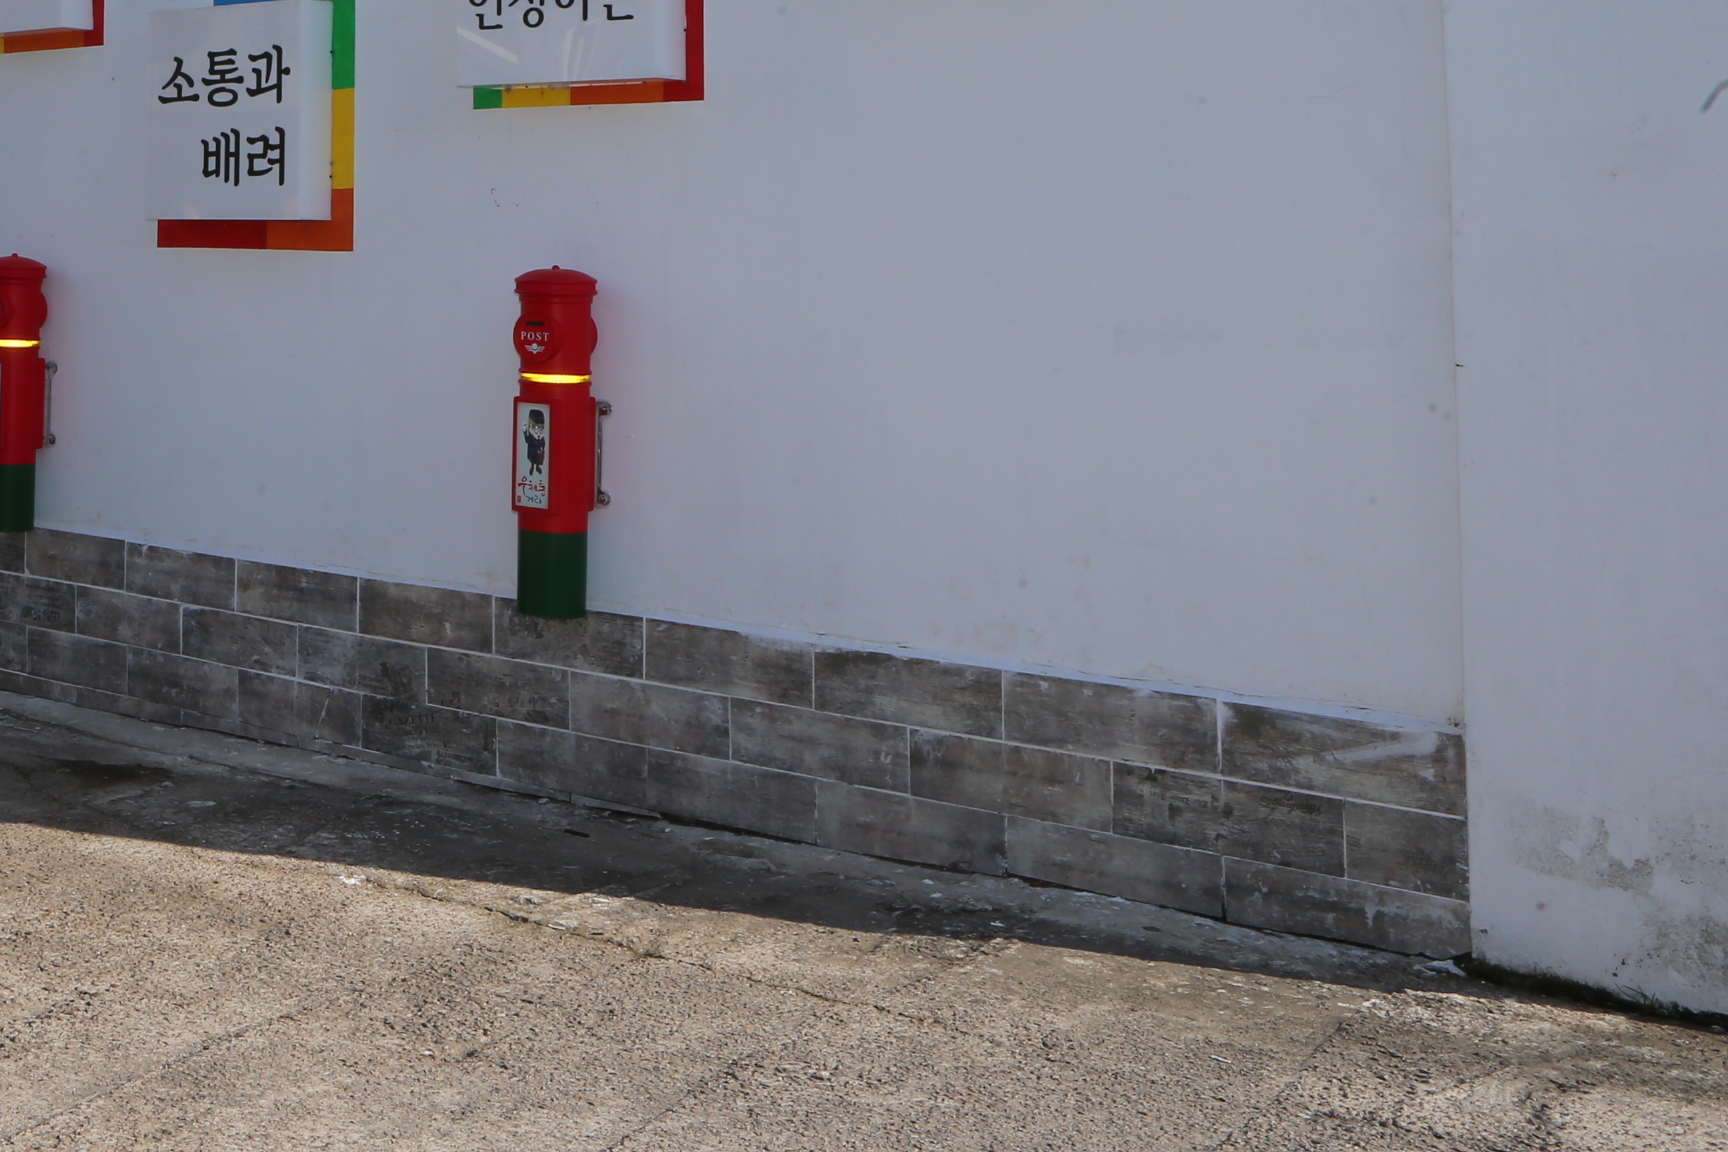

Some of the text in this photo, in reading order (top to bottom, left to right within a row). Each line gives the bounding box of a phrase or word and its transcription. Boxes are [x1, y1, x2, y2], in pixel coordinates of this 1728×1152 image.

[158, 44, 291, 107] 소통과
[201, 126, 287, 187] 배려
[520, 330, 550, 342] POST
